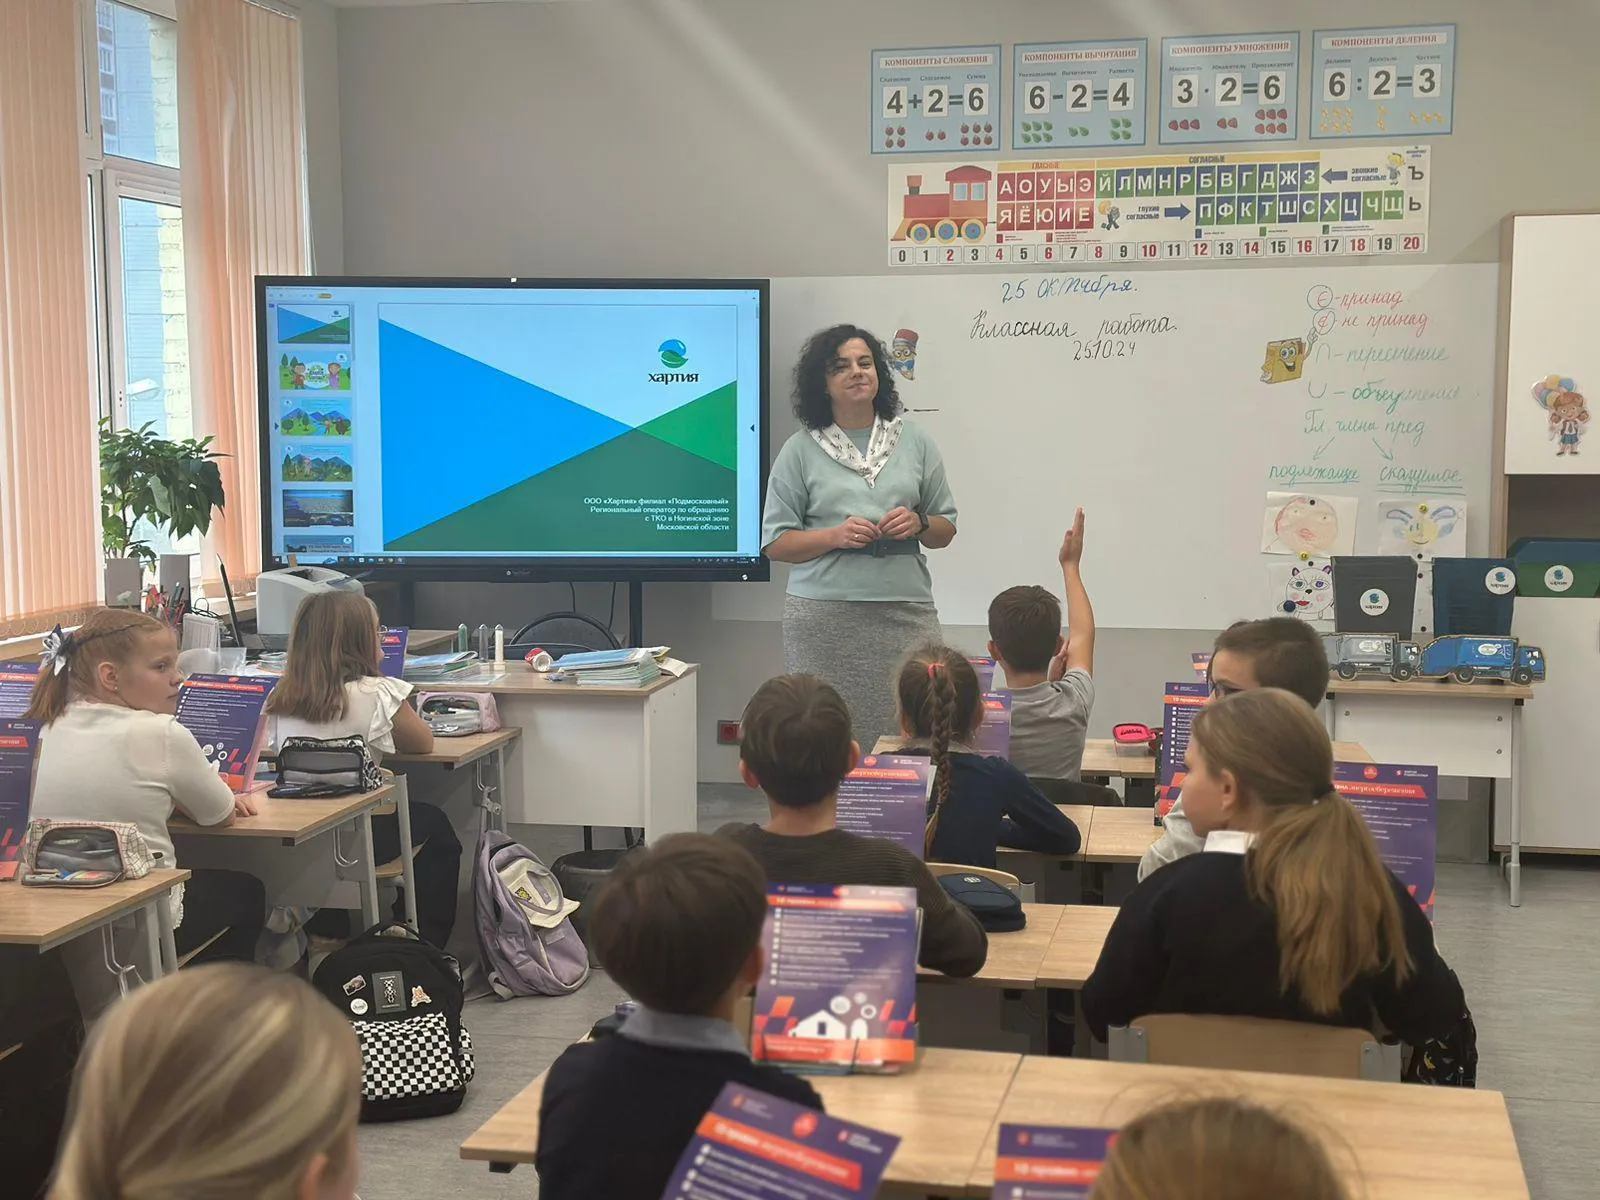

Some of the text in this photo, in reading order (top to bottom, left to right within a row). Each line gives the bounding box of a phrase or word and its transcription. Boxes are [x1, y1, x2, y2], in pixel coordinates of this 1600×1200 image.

[1331, 35, 1437, 47] КОМПОНЕНТЫ ДЕЛЕНИЯ
[1171, 42, 1289, 54] КОМПОНЕНТЫ УМНОЖЕНИЯ
[885, 56, 988, 67] КОМПОНЕНТЫ СЛОЖЕНИЯ
[1024, 50, 1137, 61] КОМПОНЕНТЫ ВЫЧИТАНИЯ
[899, 237, 1419, 262] 0 1 2 3 4 5 6 7 8 9 10 11 12 13 14 15 16 17 18 19 20
[1001, 279, 1028, 303] 25
[970, 309, 1077, 339] Классная
[648, 373, 699, 385] хартия
[687, 506, 729, 514] обращению
[674, 514, 711, 522] Ногинской
[656, 523, 699, 531] Московской
